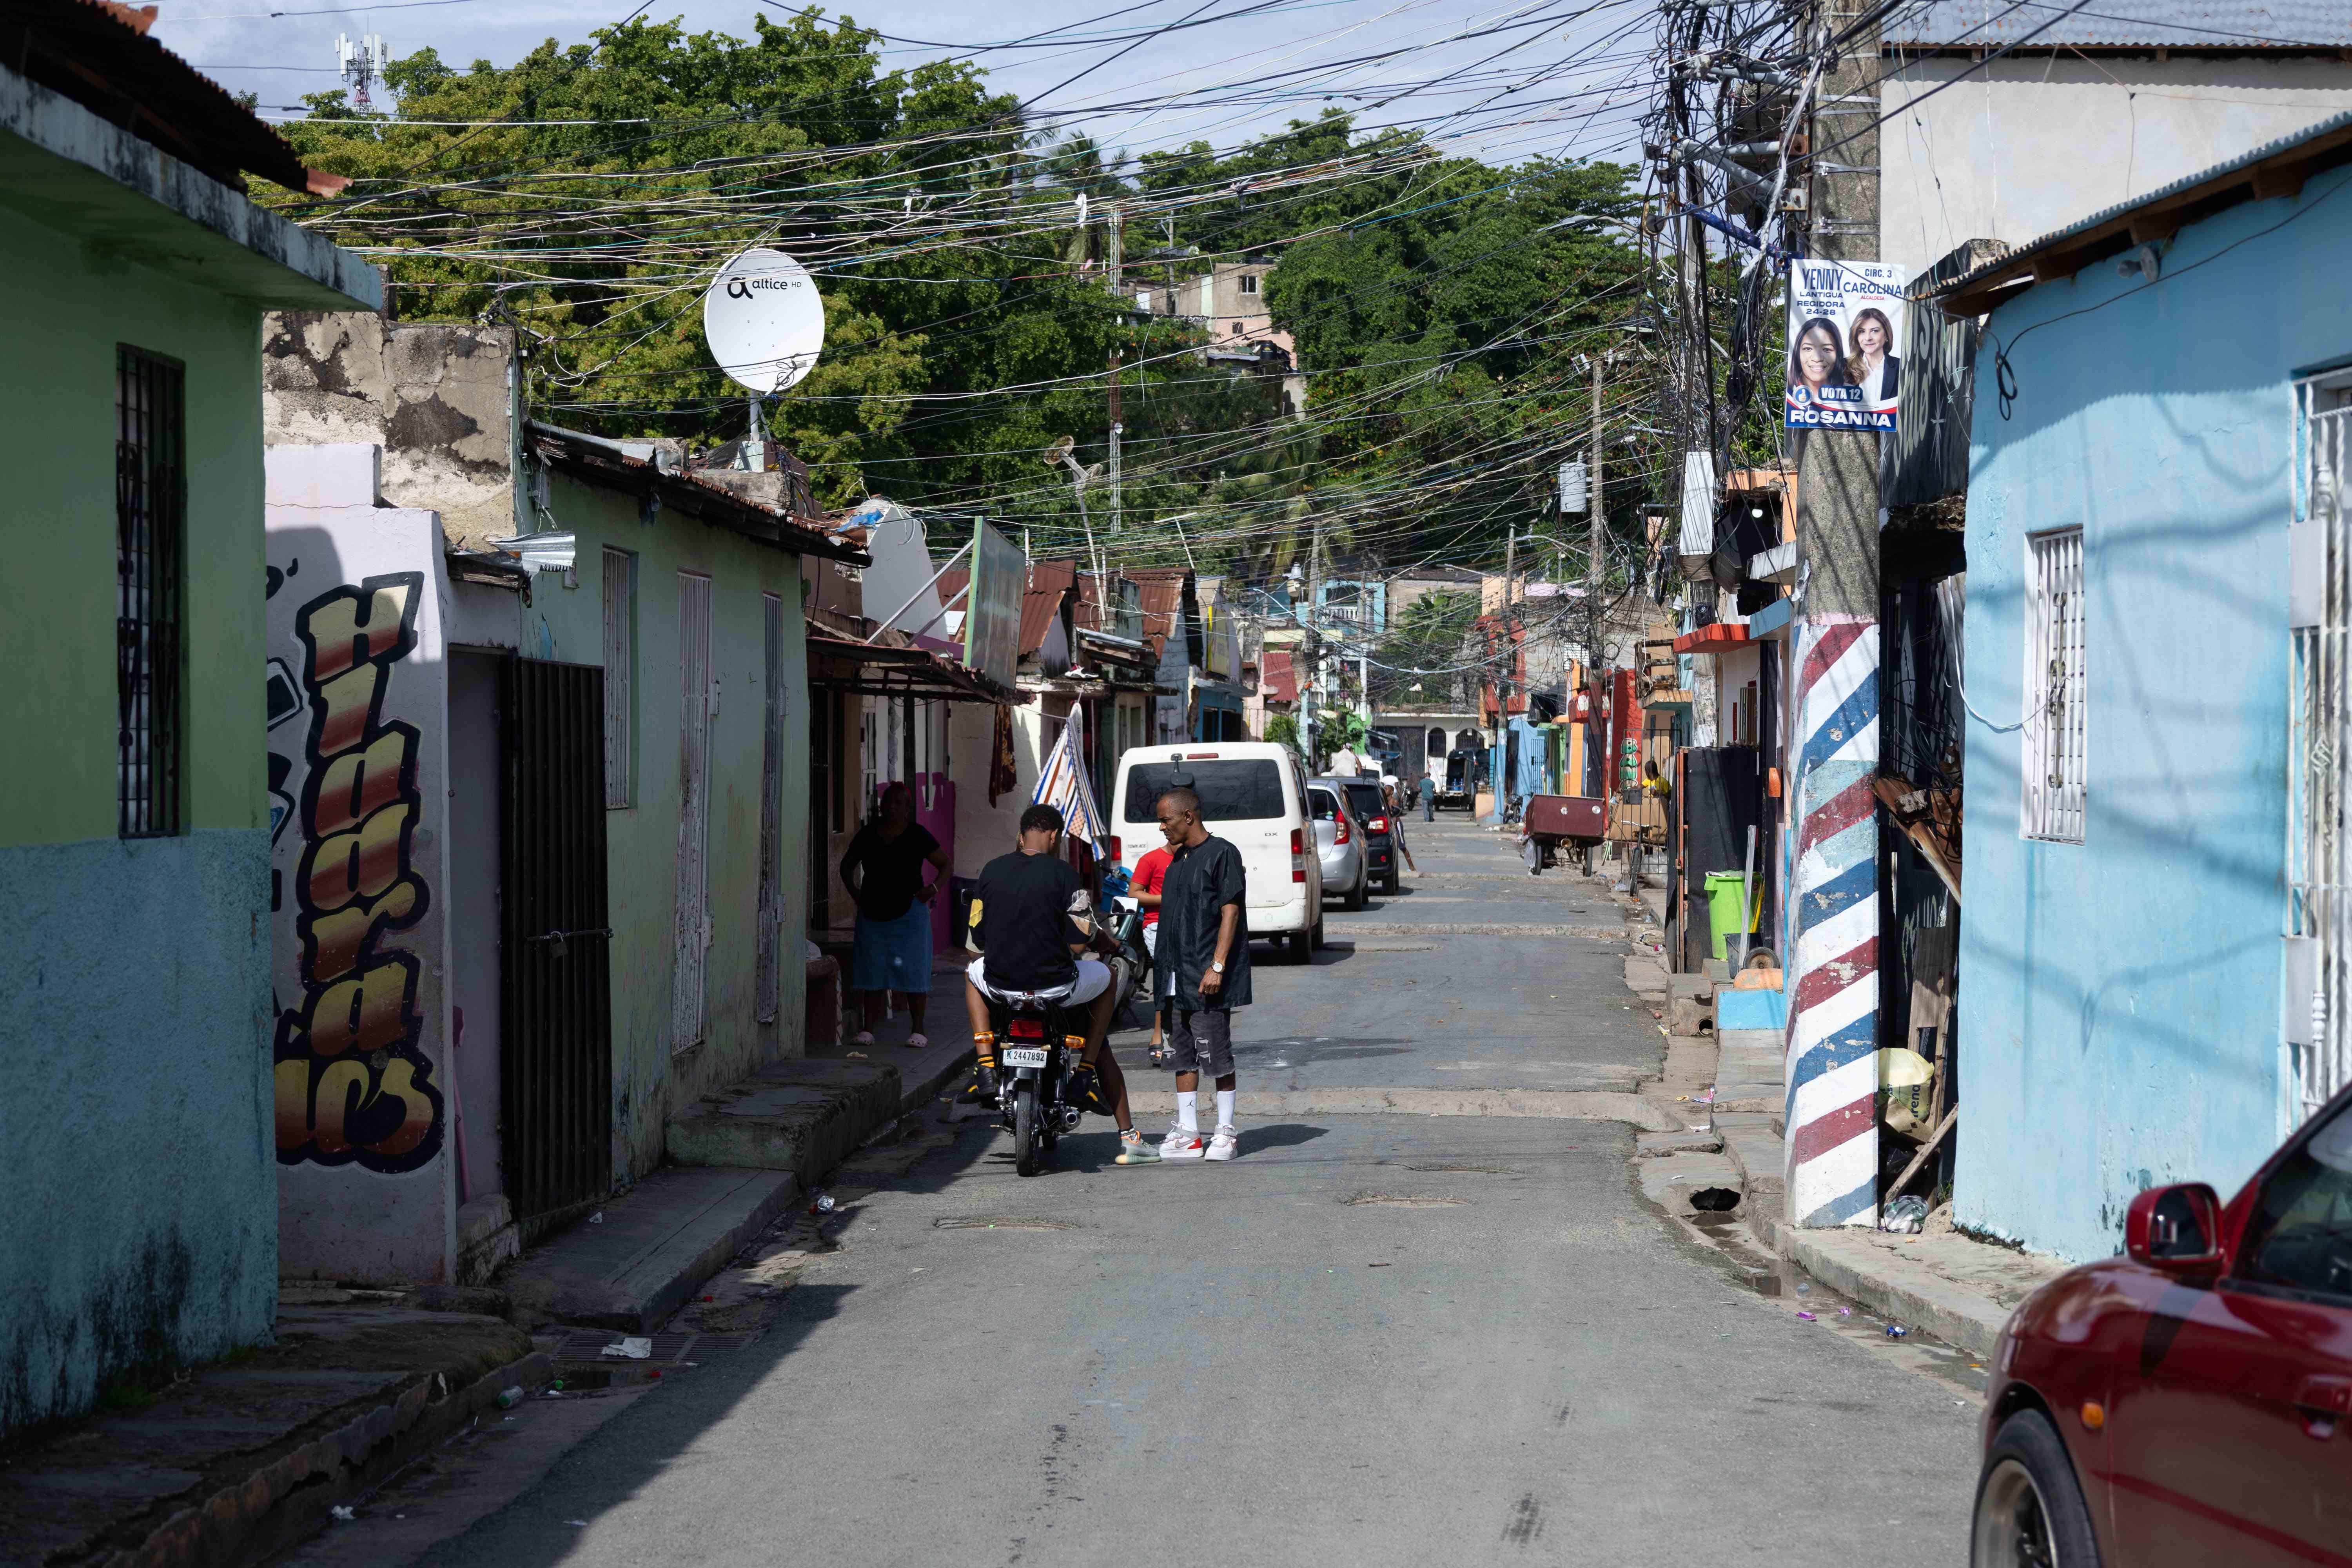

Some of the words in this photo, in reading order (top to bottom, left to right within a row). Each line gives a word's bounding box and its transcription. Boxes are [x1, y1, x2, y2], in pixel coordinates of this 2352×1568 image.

[1802, 269, 1844, 290] YENNY
[1865, 269, 1884, 278] CIRC.
[1887, 270, 1892, 278] 3
[752, 278, 788, 290] altice
[1843, 282, 1902, 296] CAROLINA
[1821, 387, 1847, 399] VOTA
[1849, 389, 1860, 400] 12
[1791, 410, 1891, 427] ROSANNA
